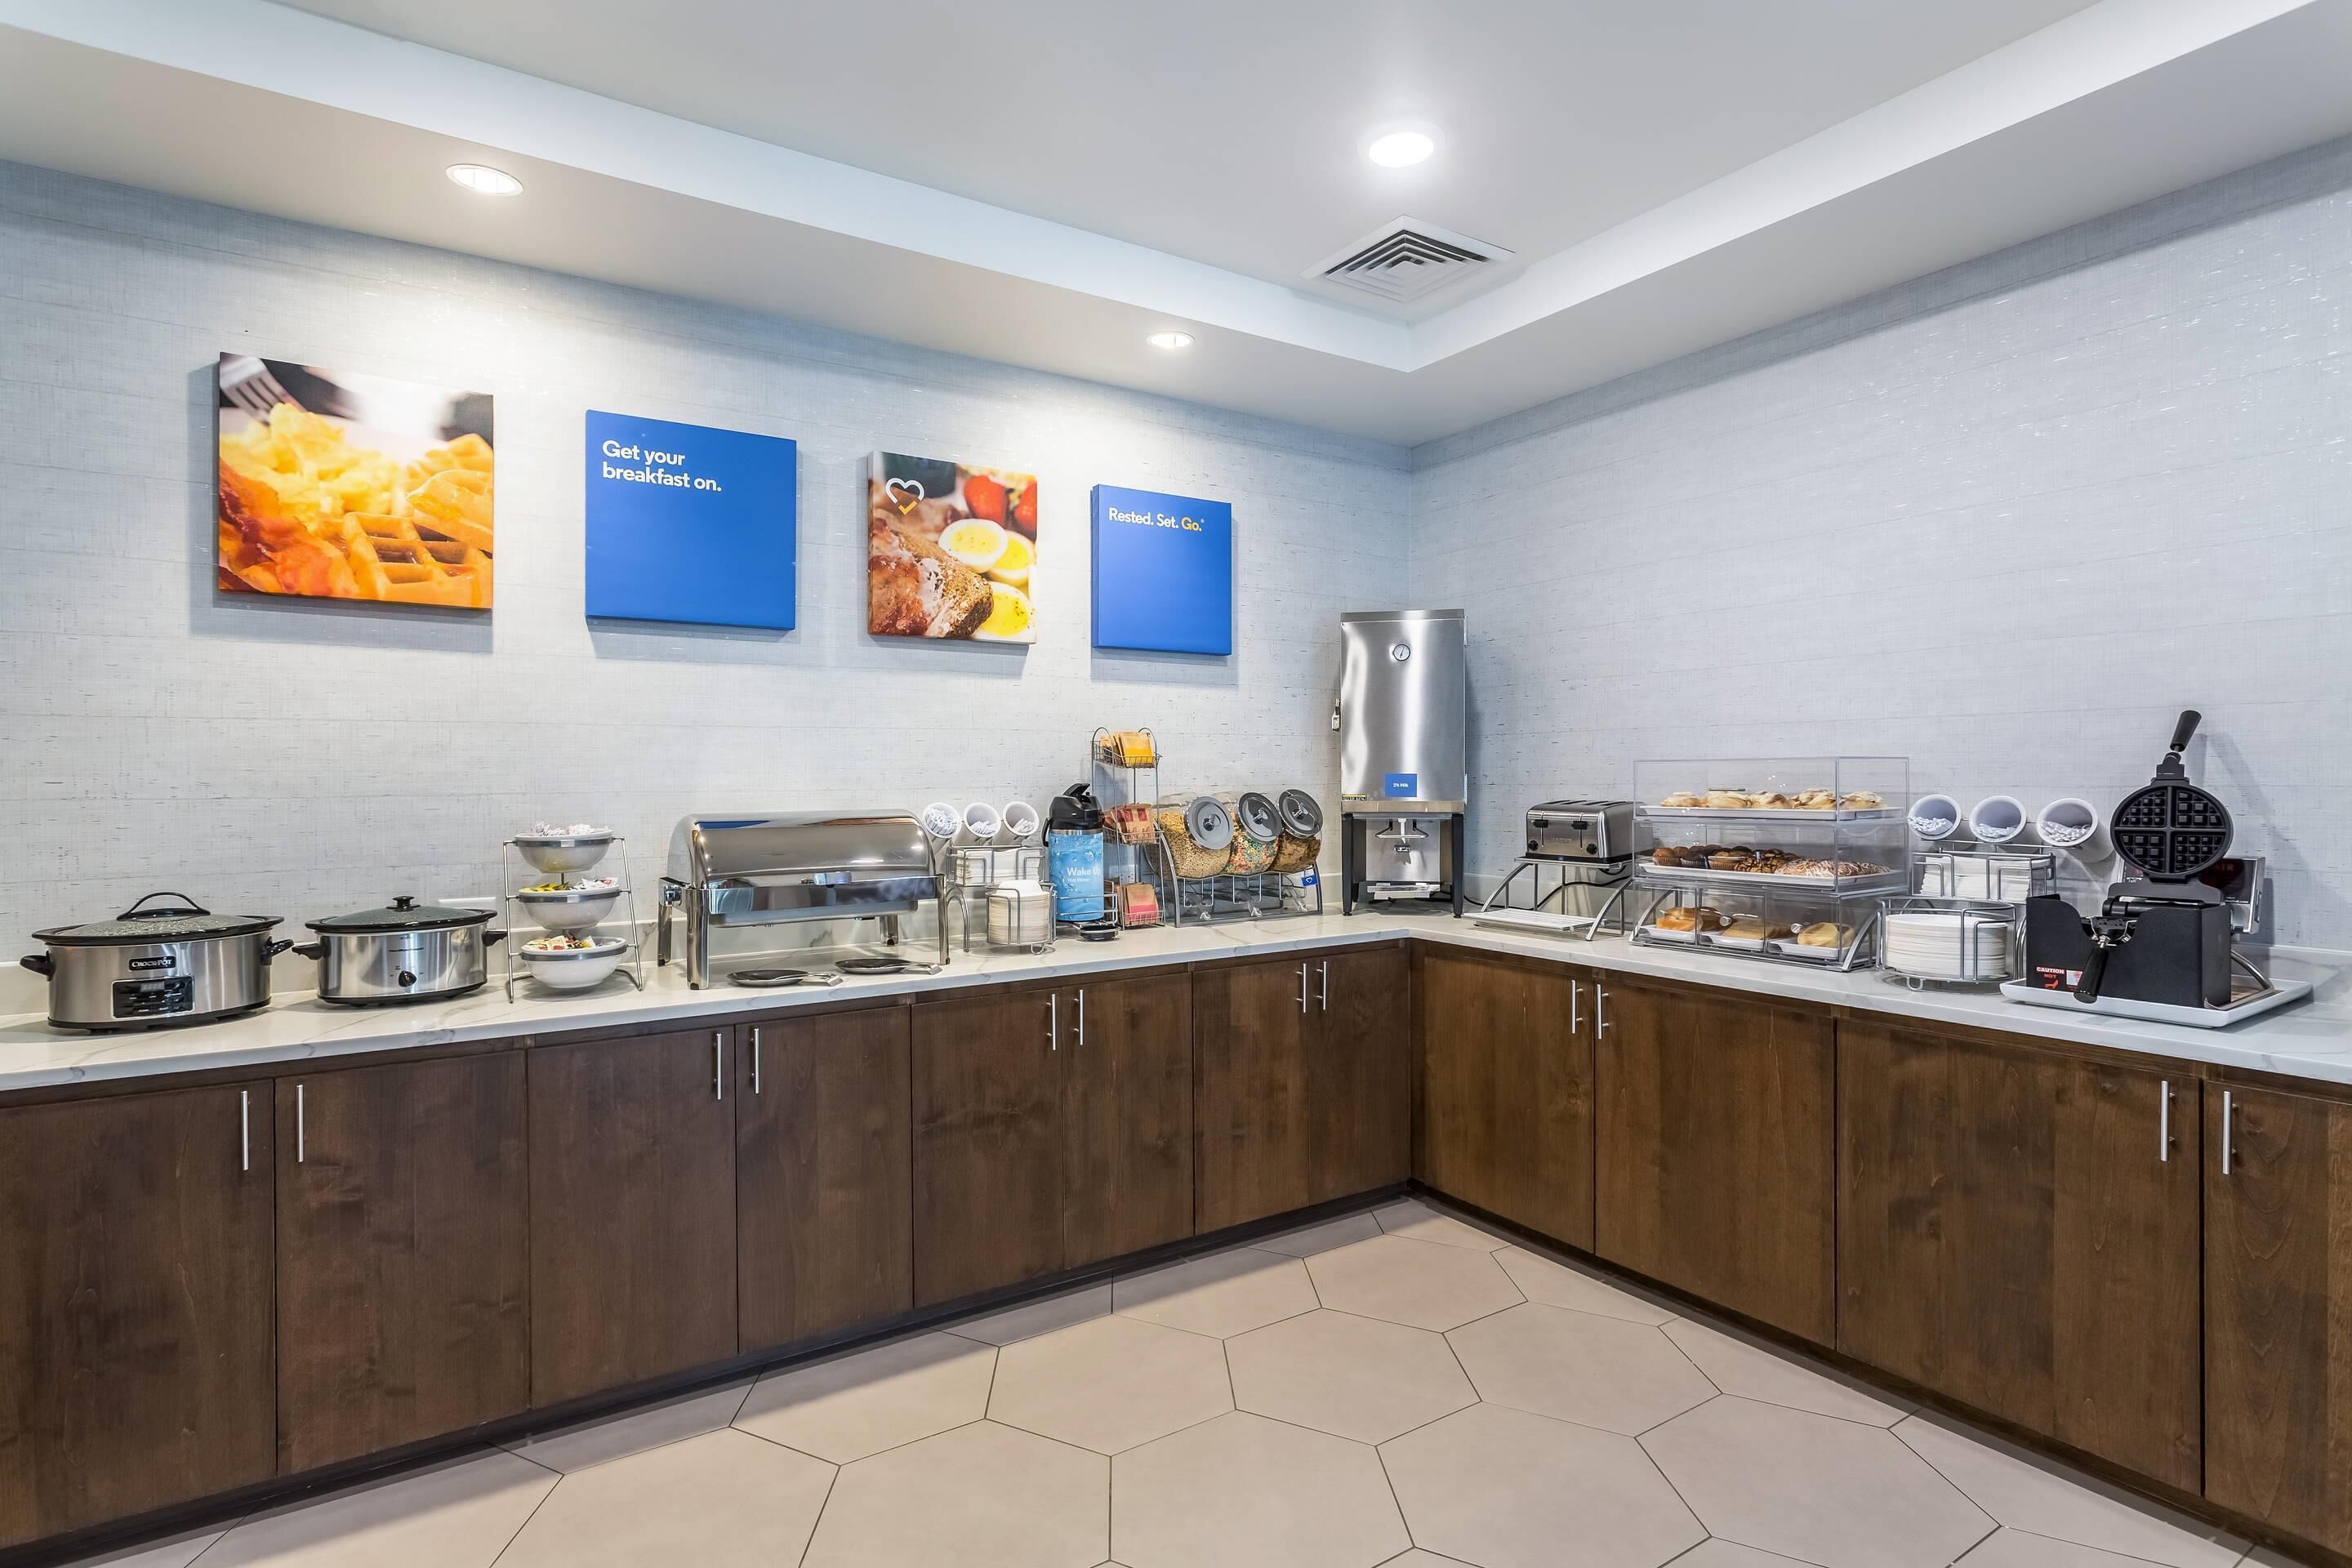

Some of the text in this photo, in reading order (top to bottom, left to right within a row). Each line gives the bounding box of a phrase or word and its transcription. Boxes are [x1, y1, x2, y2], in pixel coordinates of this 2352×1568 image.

[602, 439, 686, 466] Get your
[602, 461, 722, 492] breakfast on.
[1108, 506, 1155, 526] Rested.
[1156, 513, 1179, 529] Set.
[1067, 866, 1092, 876] Wake
[2036, 966, 2065, 974] CAUTION
